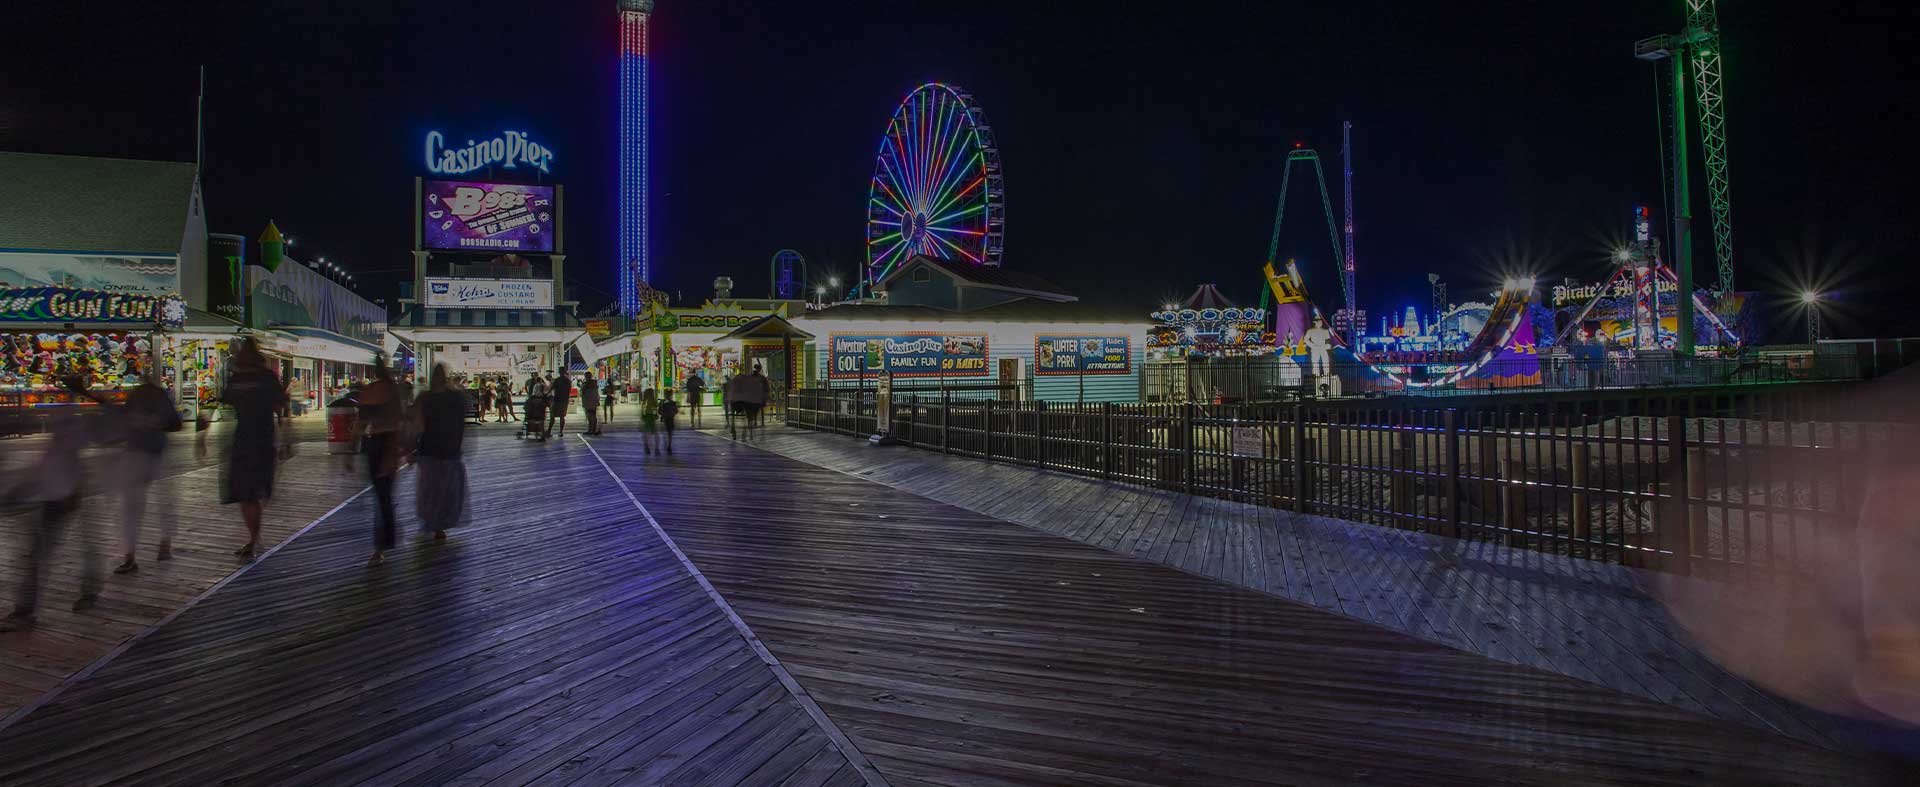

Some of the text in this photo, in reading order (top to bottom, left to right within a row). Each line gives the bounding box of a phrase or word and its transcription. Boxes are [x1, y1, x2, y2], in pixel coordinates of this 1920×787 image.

[50, 293, 101, 318] GUN
[108, 296, 154, 318] FUN
[680, 315, 725, 327] FROG
[836, 338, 867, 353] Adventure
[1053, 340, 1078, 353] WATER
[891, 357, 937, 366] FAMILY FUN
[942, 358, 984, 369] GO KARTS
[1056, 355, 1076, 368] PARK
